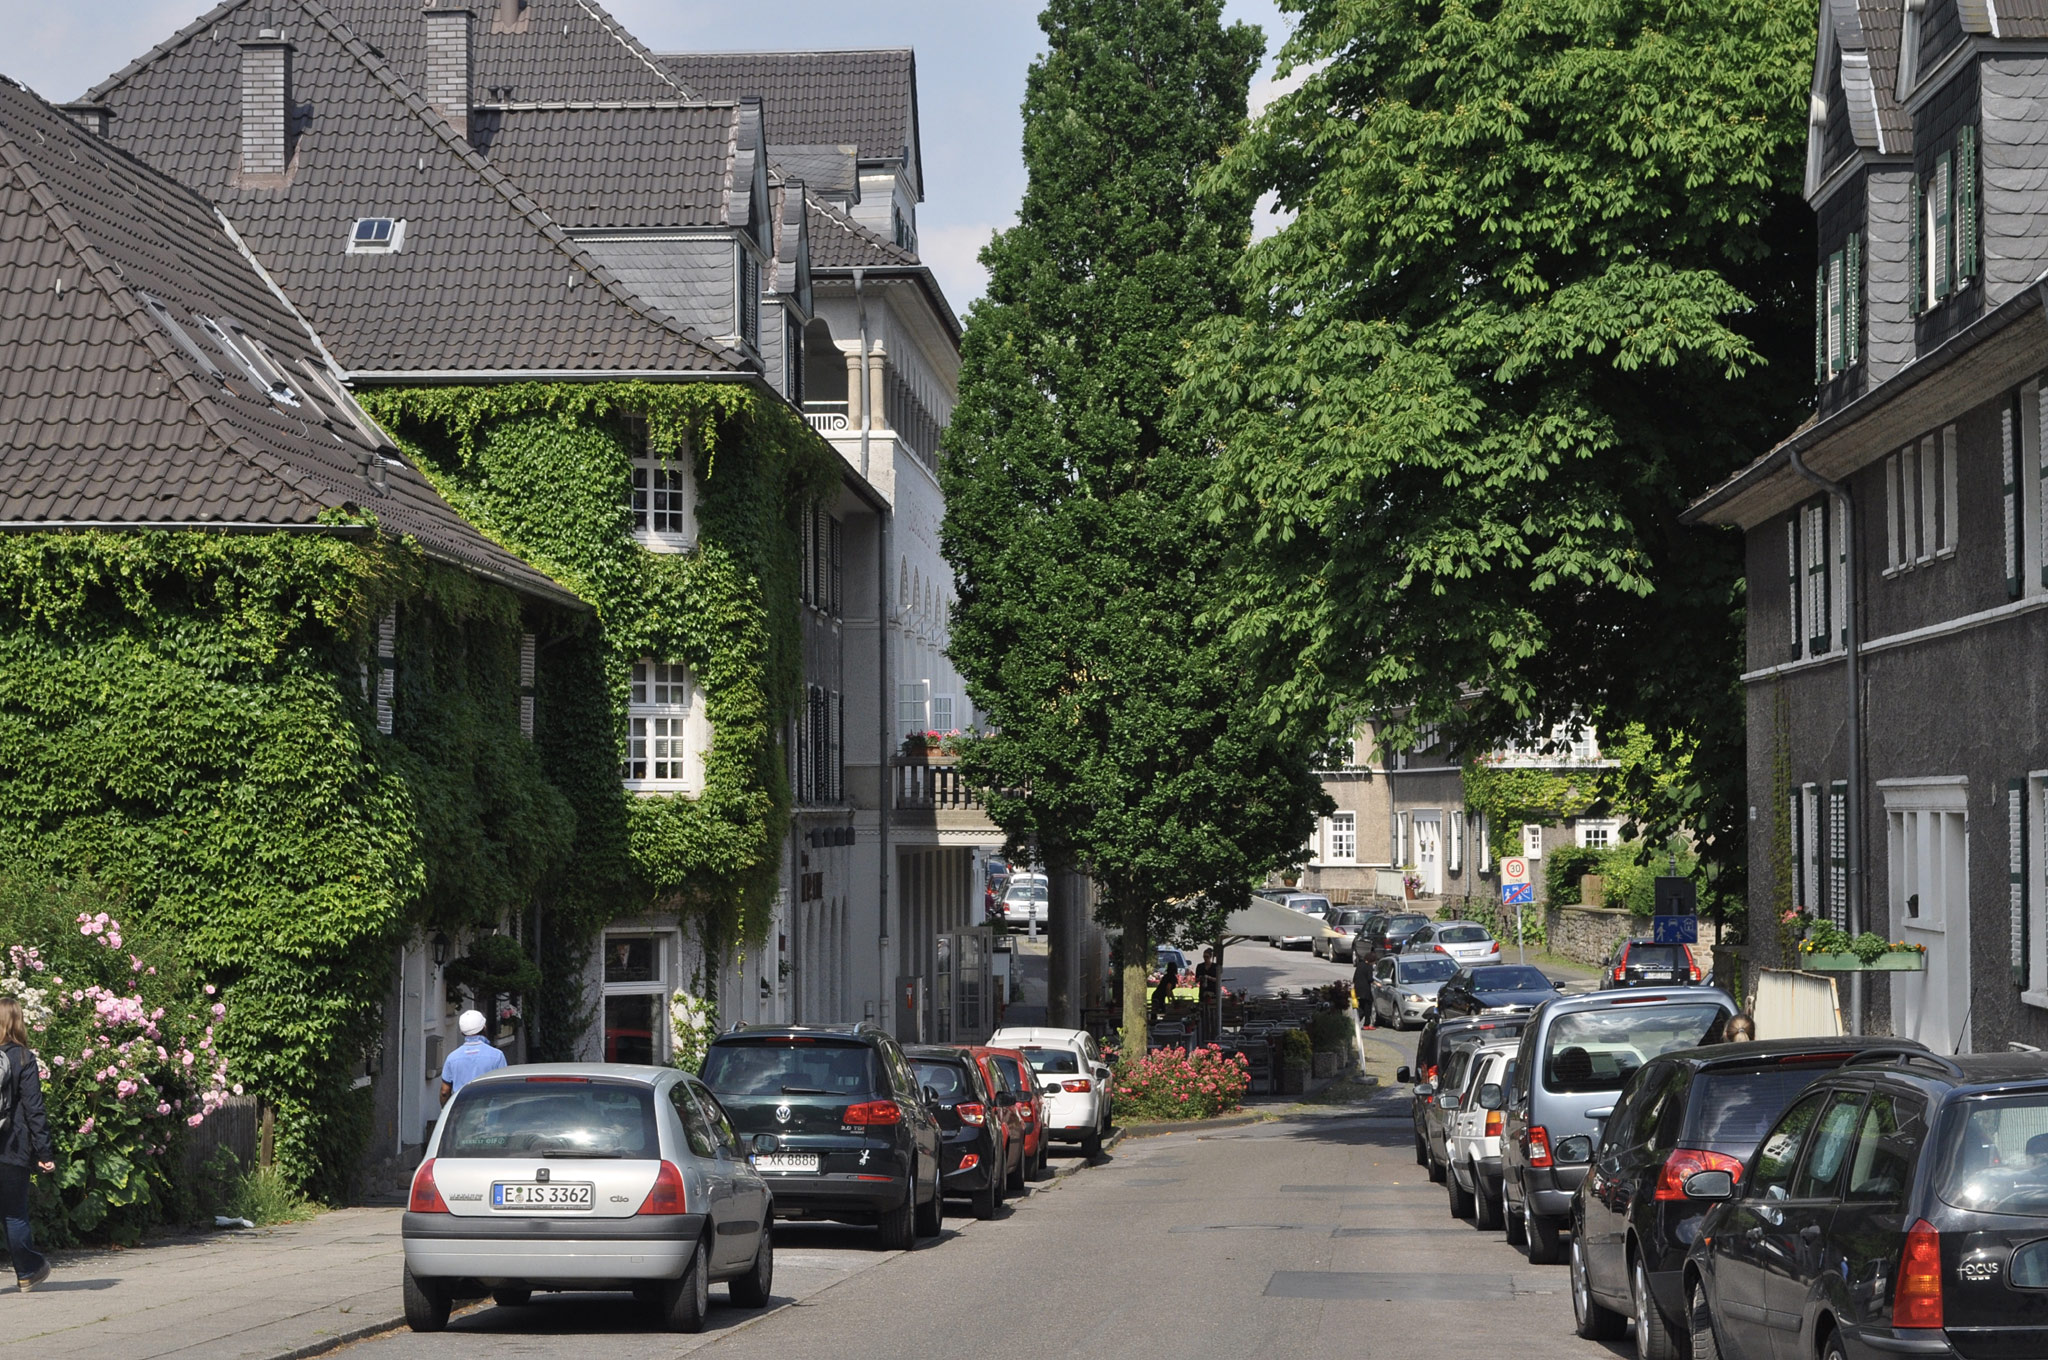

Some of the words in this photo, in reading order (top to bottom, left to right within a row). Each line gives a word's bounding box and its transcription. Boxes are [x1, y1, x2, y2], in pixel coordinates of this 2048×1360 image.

[1510, 864, 1521, 873] 30
[755, 1155, 762, 1166] E
[770, 1154, 784, 1166] XK
[787, 1154, 817, 1166] 8888
[505, 1187, 515, 1203] E
[526, 1187, 545, 1203] IS
[548, 1187, 589, 1203] 3362
[609, 1194, 630, 1203] Clio
